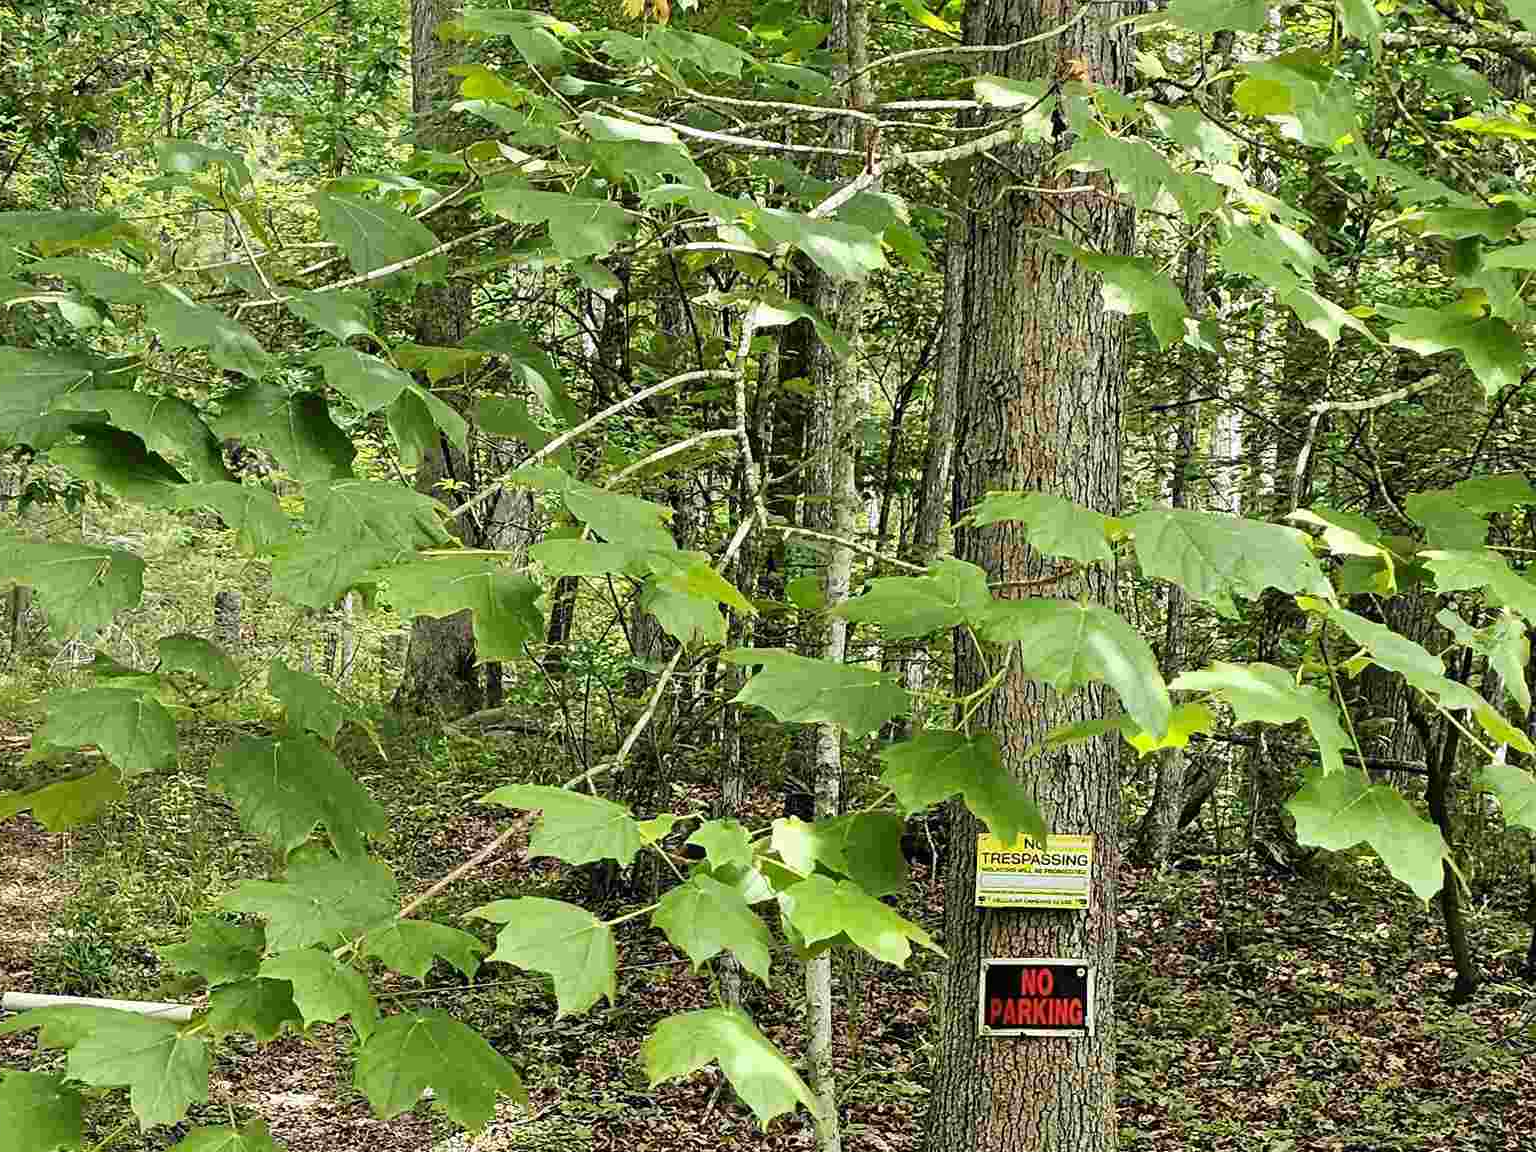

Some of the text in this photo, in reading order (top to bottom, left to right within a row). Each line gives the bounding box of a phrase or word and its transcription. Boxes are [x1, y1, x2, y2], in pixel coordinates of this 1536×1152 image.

[981, 852, 1089, 866] TRESPASSING
[1021, 967, 1054, 996] NO
[990, 998, 1083, 1025] PARKING
